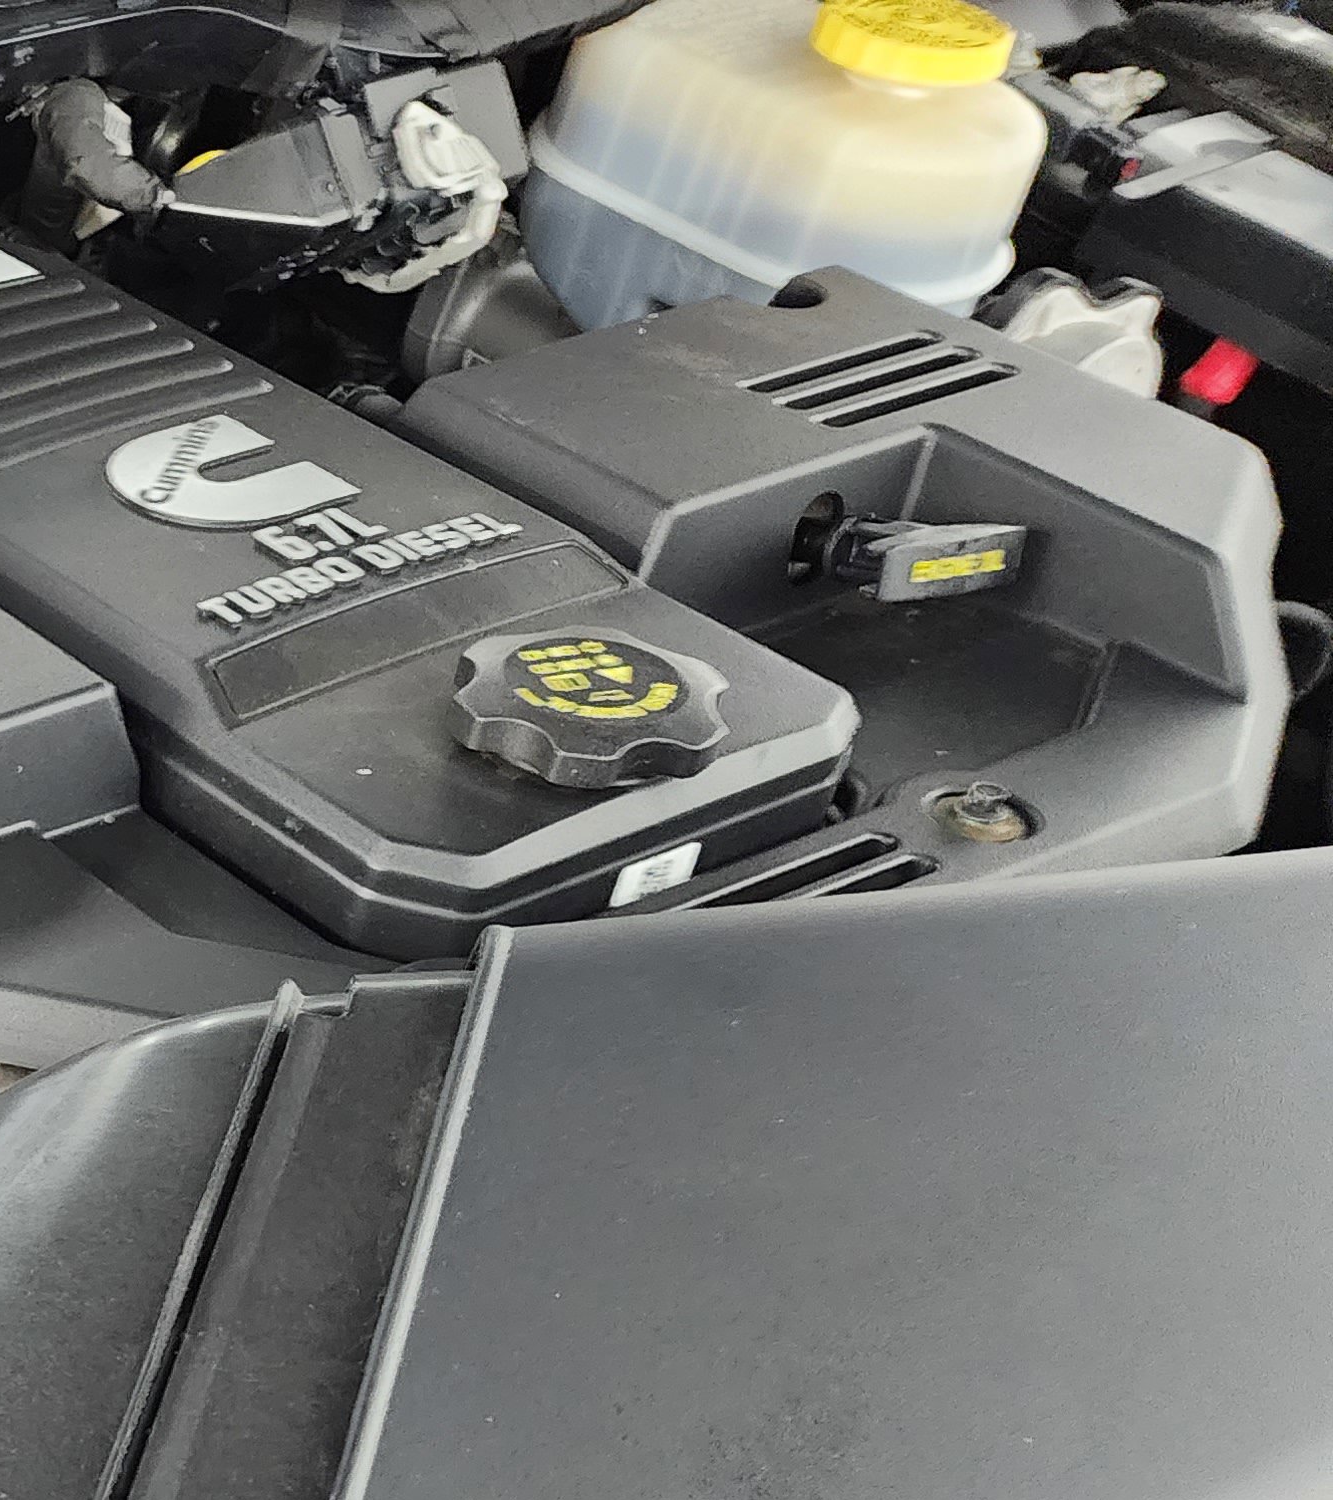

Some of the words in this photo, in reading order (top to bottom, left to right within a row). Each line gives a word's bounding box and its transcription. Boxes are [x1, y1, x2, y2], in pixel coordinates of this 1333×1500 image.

[139, 421, 221, 504] Cummins
[196, 556, 366, 625] TURBO
[351, 512, 524, 572] DIESEL
[251, 508, 389, 562] 6.7L
